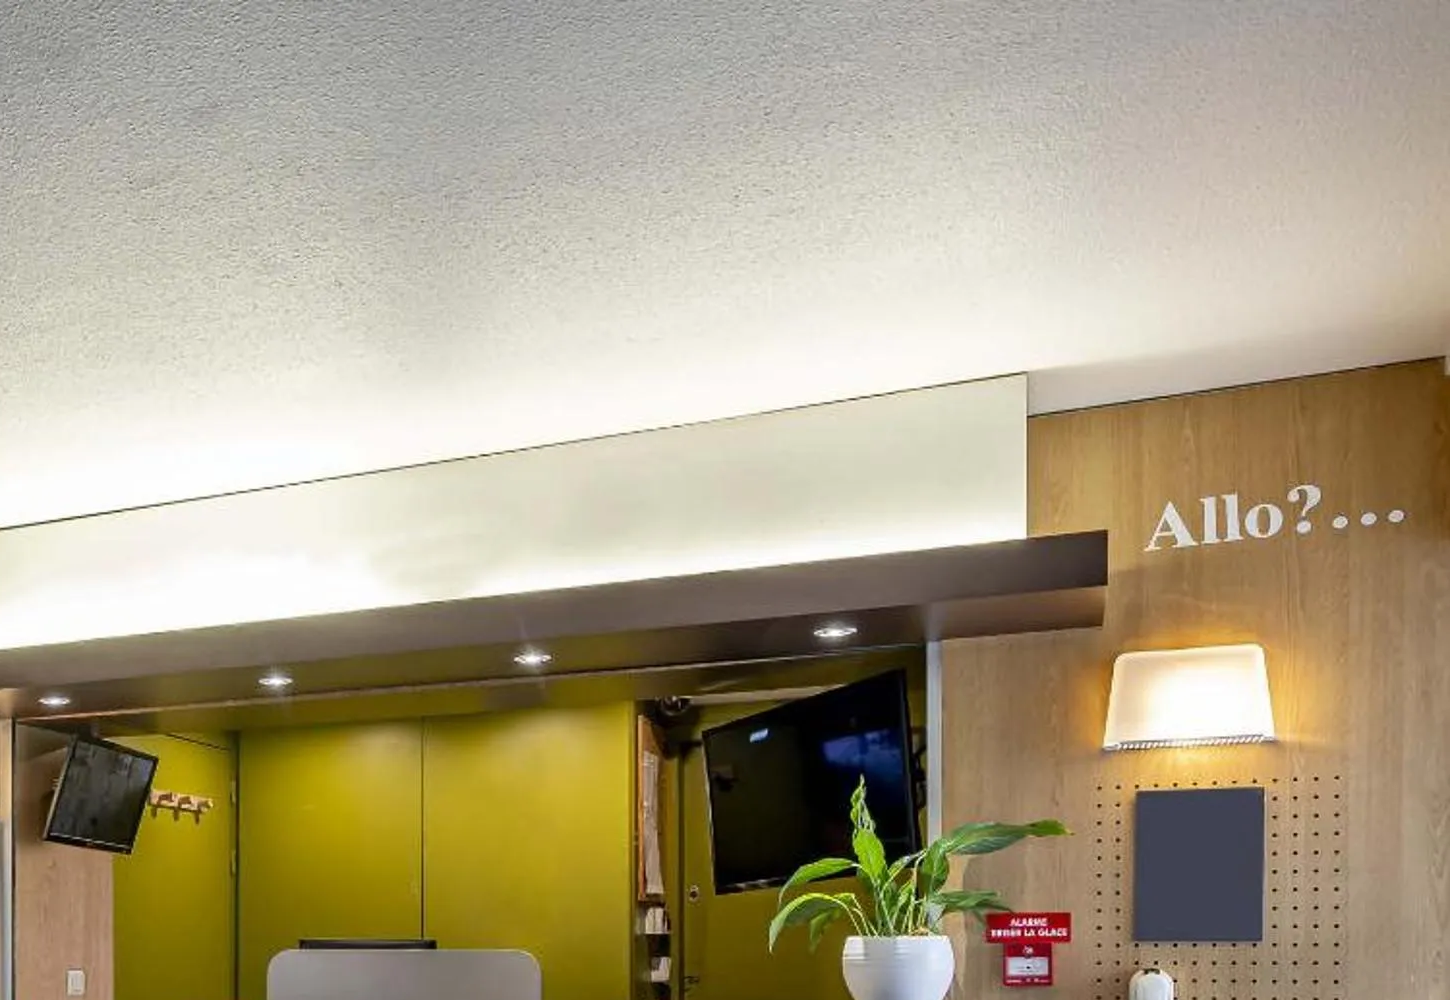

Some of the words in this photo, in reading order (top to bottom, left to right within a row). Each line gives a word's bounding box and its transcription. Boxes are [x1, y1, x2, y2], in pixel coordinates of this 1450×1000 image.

[1010, 918, 1047, 927] ALARME
[1024, 929, 1036, 937] LA
[1037, 928, 1068, 937] GLACE
